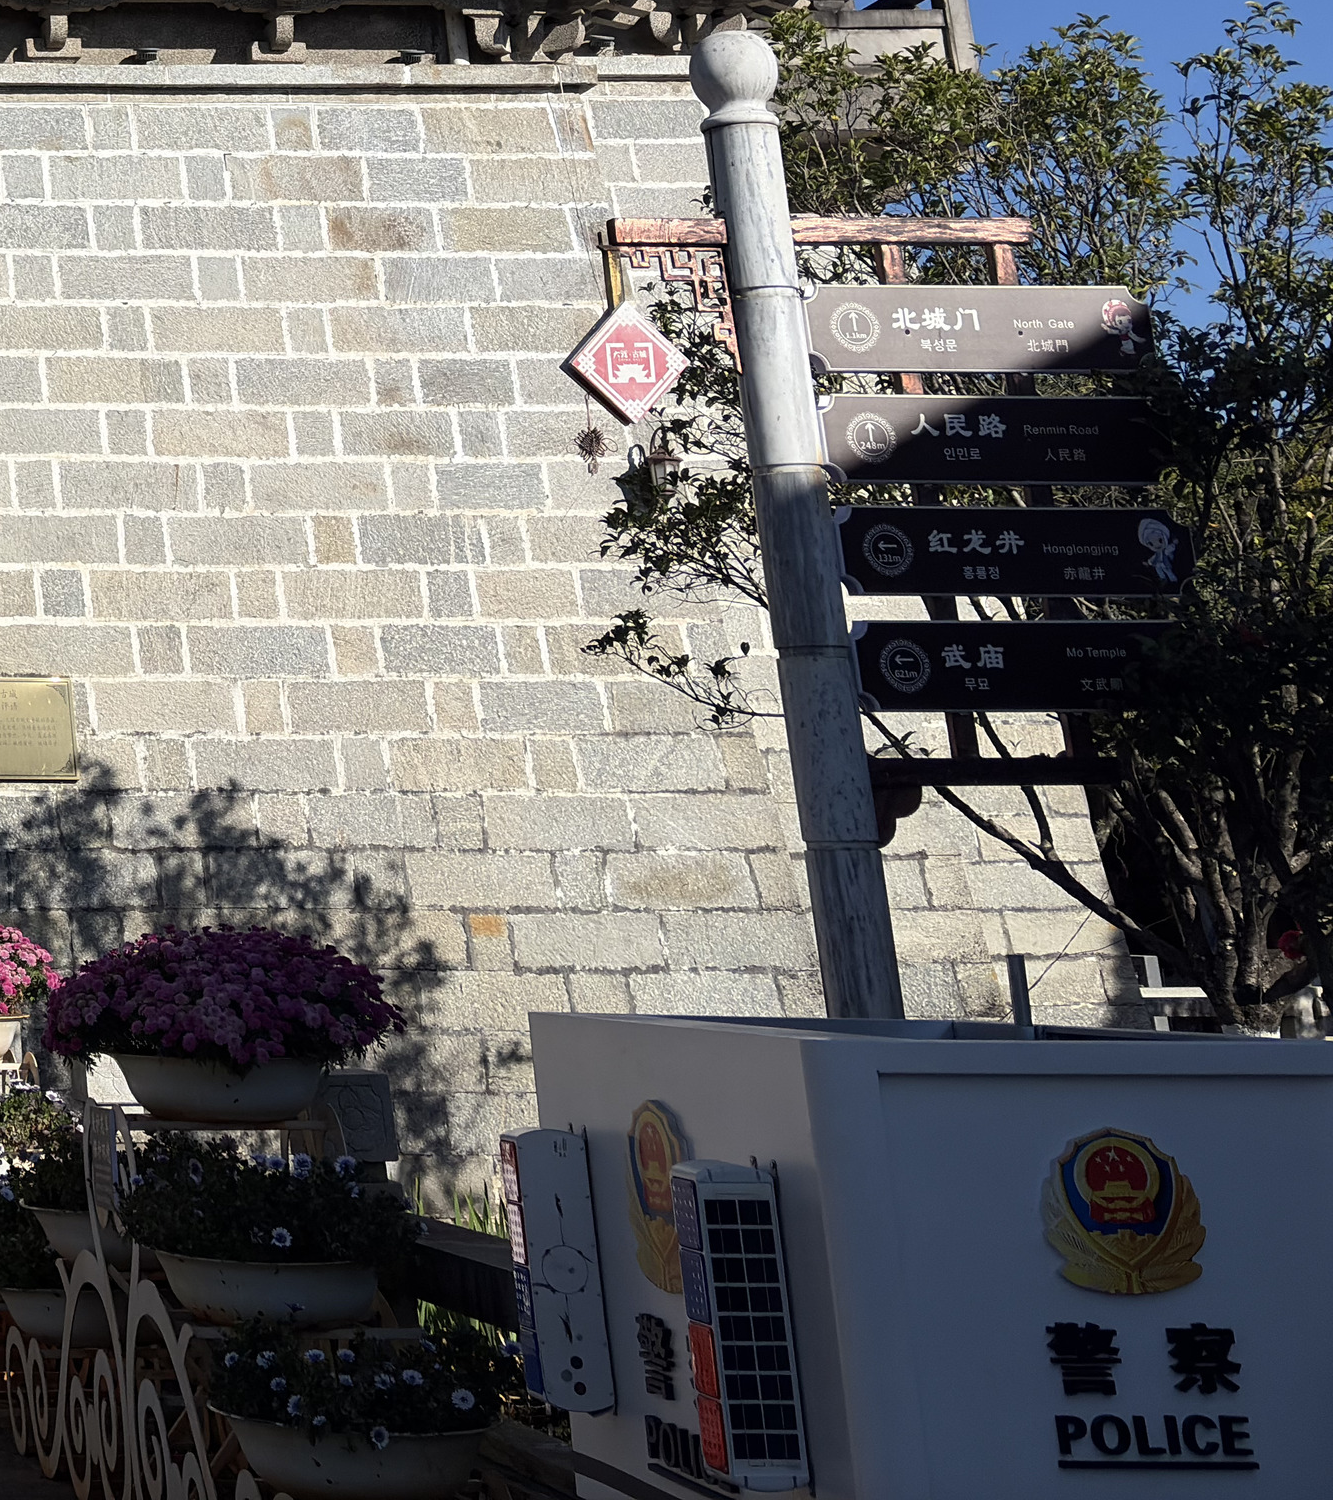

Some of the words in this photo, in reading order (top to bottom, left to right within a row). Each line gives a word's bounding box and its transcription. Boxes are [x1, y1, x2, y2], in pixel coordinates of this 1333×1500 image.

[891, 307, 981, 331] 北城门
[1013, 318, 1043, 329] North
[1049, 318, 1075, 329] Gate
[845, 332, 867, 340] 1.1km
[920, 338, 958, 352] 북성문
[1027, 339, 1069, 353] 北城門
[910, 413, 1007, 438] 人民路
[1023, 424, 1067, 436] Renmin
[1069, 424, 1099, 435] Road
[860, 441, 885, 451] 248m
[943, 448, 982, 461] 인민로
[1044, 449, 1086, 462] 人民路
[928, 529, 1025, 555] 红龙井
[1043, 543, 1119, 556] Honglongjing
[878, 553, 902, 563] 131m
[941, 644, 1005, 669] 武庙
[1066, 647, 1083, 658] Mo
[1085, 647, 1126, 659] Temple
[894, 669, 918, 679] 621m
[965, 678, 990, 691] 무묘
[1046, 1322, 1242, 1396] 警察
[1055, 1414, 1254, 1456] POLICE
